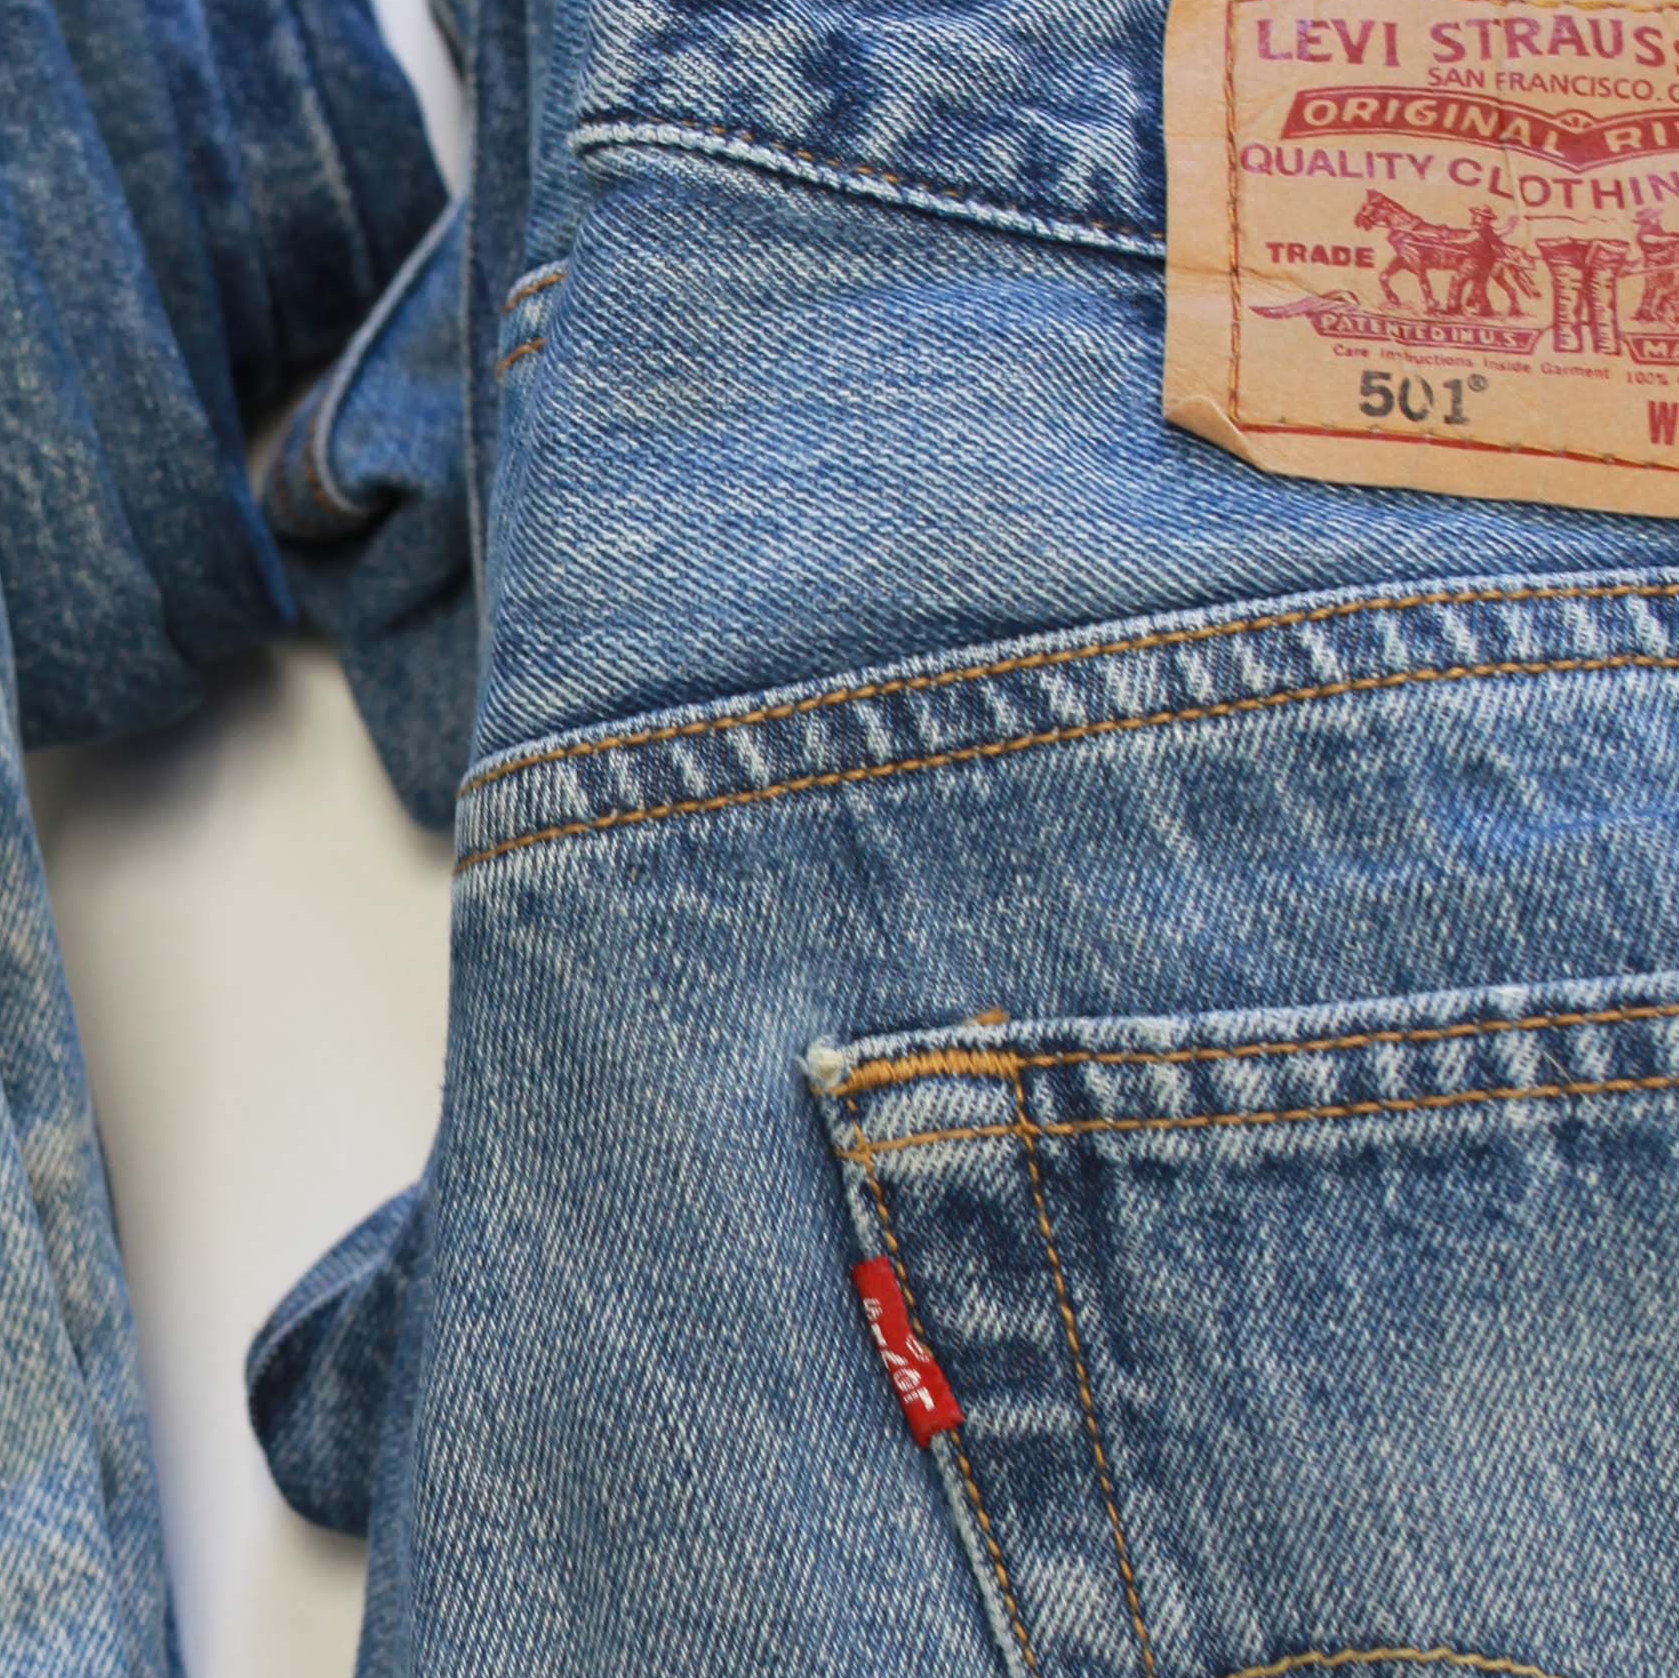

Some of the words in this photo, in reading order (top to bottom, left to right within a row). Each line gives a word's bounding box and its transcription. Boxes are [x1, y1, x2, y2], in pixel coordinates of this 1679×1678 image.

[1257, 19, 1401, 67] LEVI
[1430, 14, 1679, 68] STRAUS
[1426, 67, 1485, 89] SAN
[1302, 97, 1565, 160] ORIGINAL
[1604, 119, 1679, 154] RI
[1240, 141, 1435, 181] QUALITY
[1266, 242, 1375, 268] TRADE
[1322, 312, 1447, 342] PATENTED
[1332, 343, 1369, 358] Care
[1540, 361, 1610, 381] Garment
